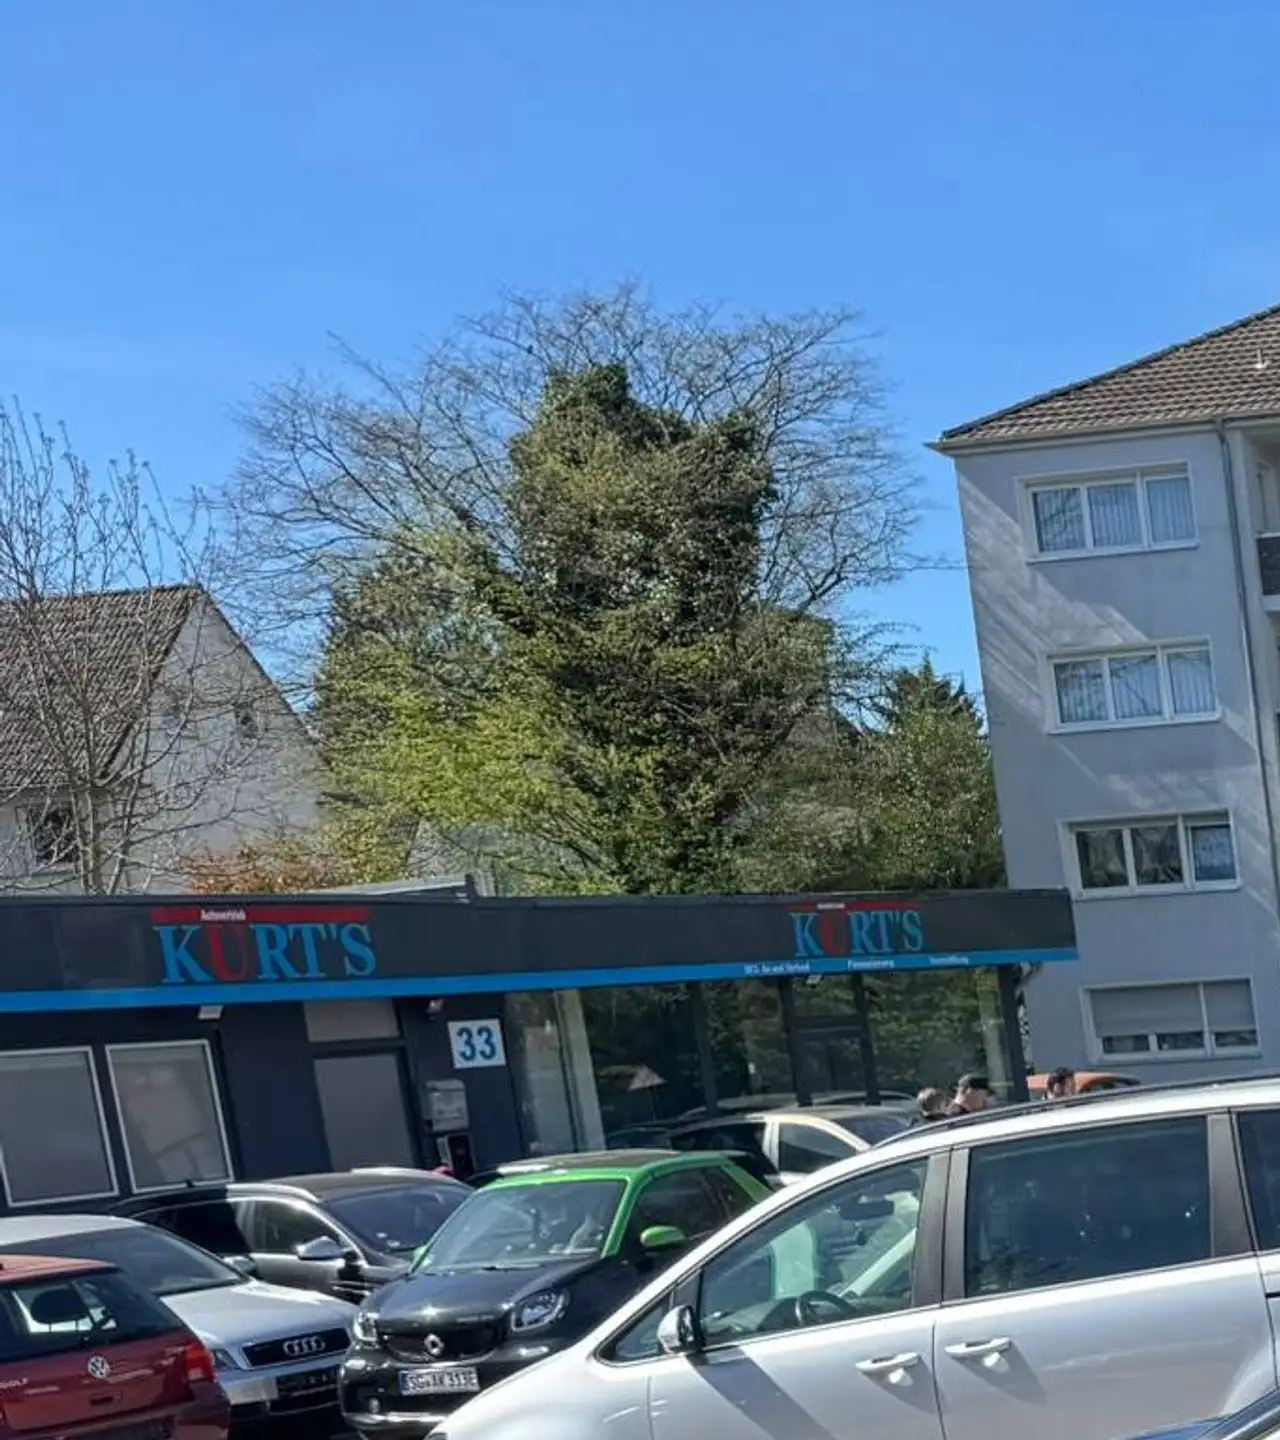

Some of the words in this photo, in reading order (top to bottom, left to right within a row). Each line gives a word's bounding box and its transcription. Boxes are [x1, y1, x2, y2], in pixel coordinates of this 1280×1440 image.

[153, 921, 376, 984] KURT'S
[788, 909, 923, 957] KURT'S
[456, 1026, 496, 1060] 33
